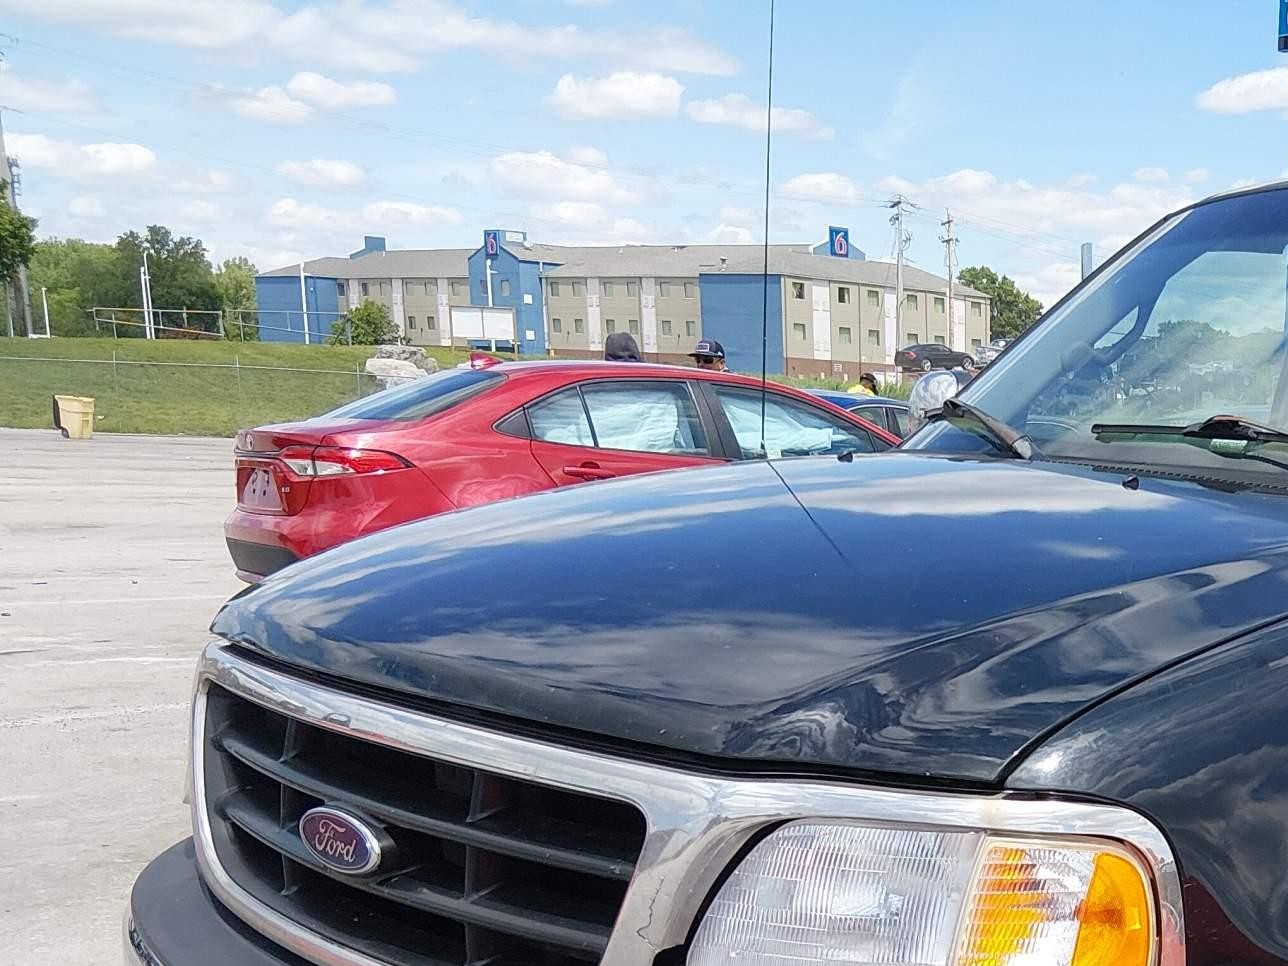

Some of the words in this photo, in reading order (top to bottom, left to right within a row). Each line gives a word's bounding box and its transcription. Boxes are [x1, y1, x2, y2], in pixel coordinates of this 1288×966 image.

[486, 233, 497, 255] 6
[834, 231, 848, 255] 6
[315, 819, 357, 863] Ford
